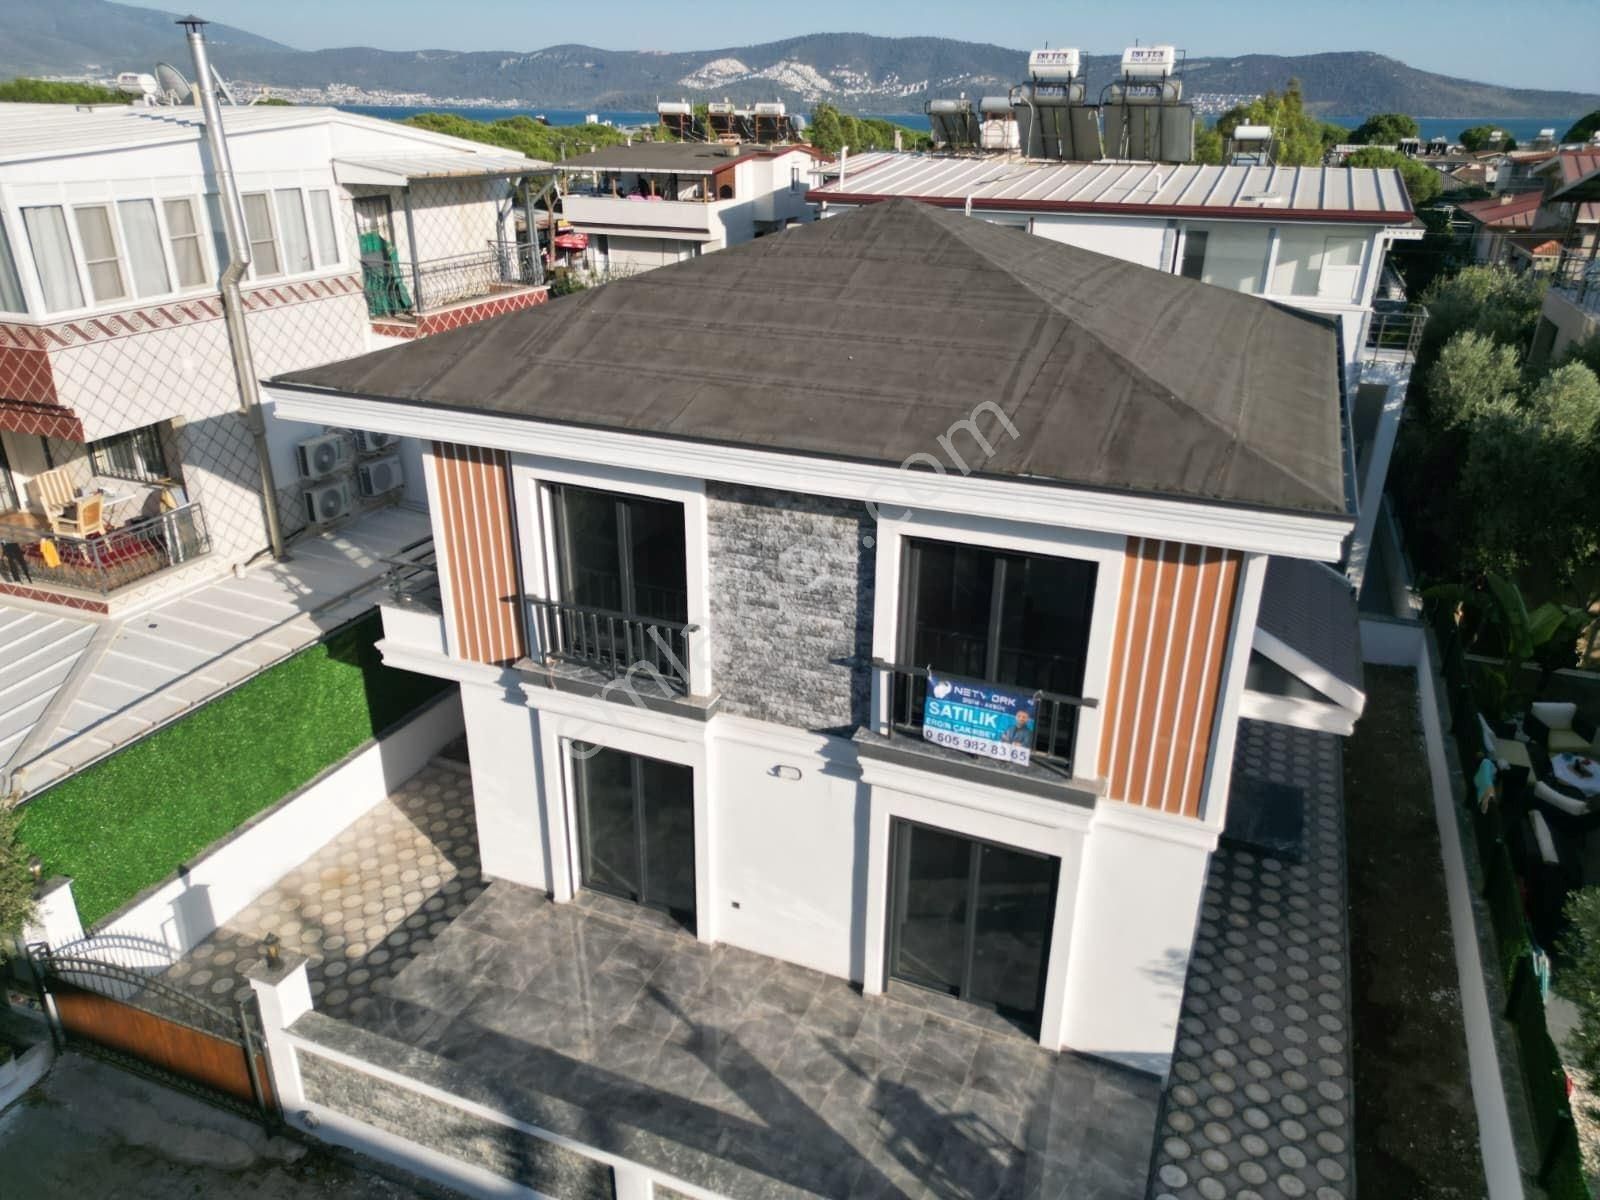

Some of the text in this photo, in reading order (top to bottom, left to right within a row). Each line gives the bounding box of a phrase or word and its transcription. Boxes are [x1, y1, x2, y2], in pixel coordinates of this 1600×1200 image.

[928, 701, 998, 728] SATILIK
[925, 730, 933, 739] 0
[963, 739, 987, 752] 982
[991, 744, 1007, 756] 83
[1010, 749, 1026, 761] 65
